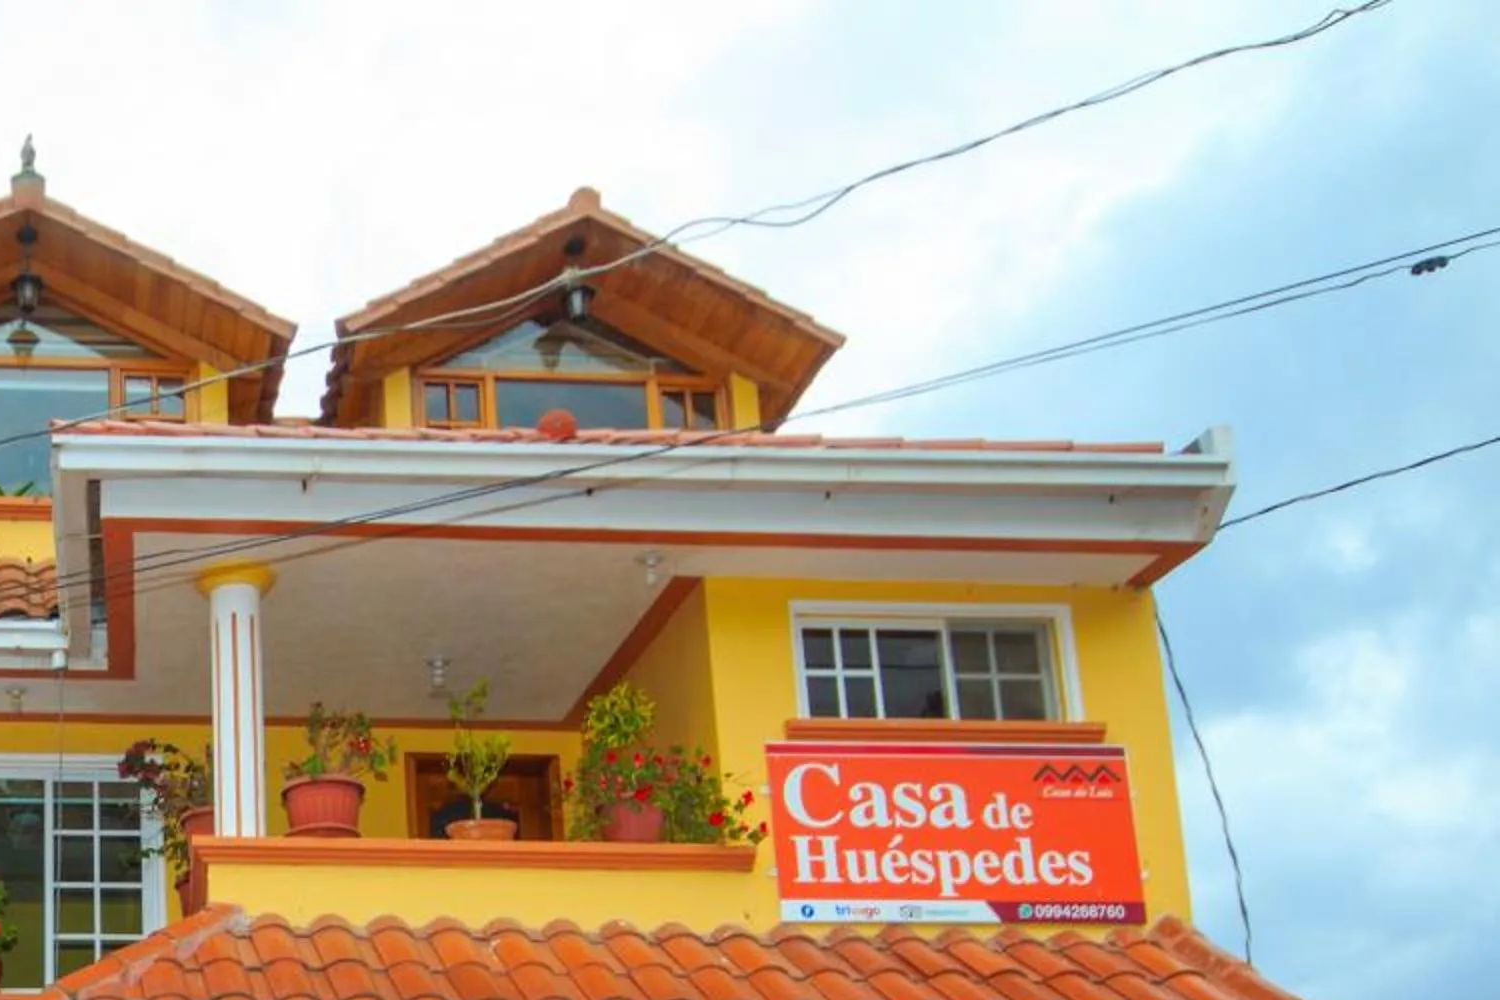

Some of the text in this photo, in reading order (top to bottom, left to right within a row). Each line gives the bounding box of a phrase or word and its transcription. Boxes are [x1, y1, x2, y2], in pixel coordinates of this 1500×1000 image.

[783, 763, 1033, 829] Casa de
[790, 835, 1093, 897] Huéspedes
